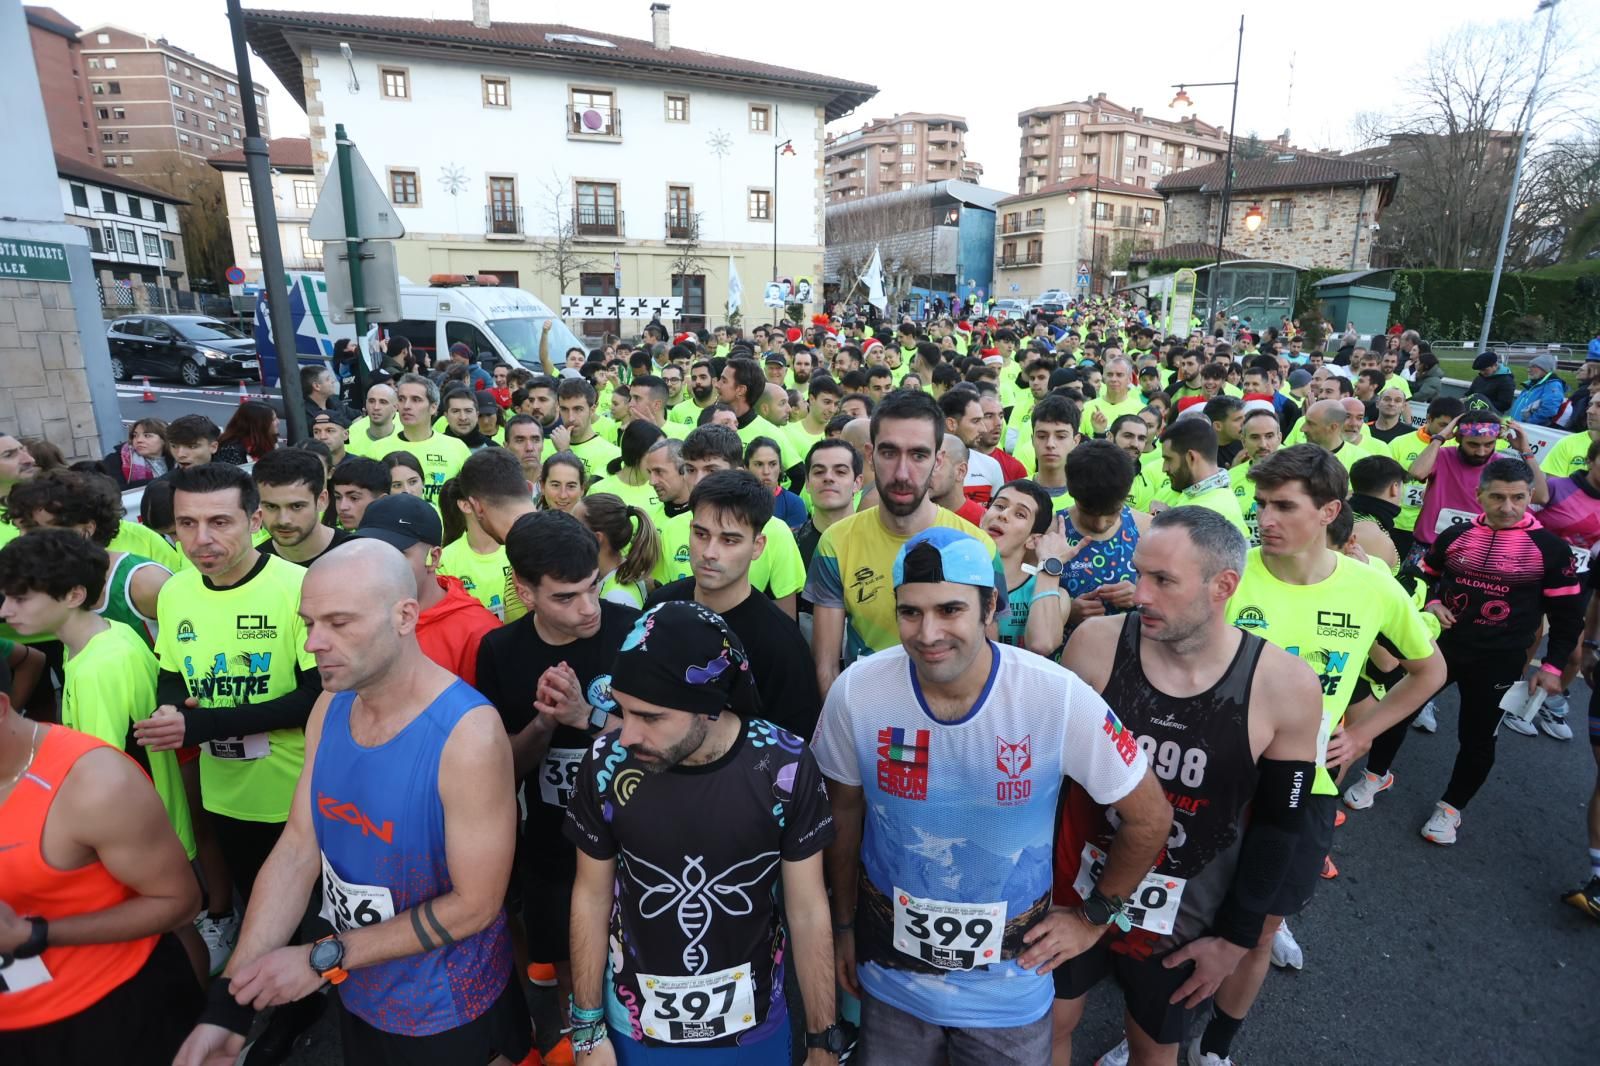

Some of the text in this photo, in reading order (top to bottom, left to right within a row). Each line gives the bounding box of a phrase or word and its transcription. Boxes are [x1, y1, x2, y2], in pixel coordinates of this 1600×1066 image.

[20, 244, 64, 261] URIARTE
[1455, 576, 1510, 593] GALDAKAO
[996, 779, 1032, 801] OTSO
[1288, 771, 1304, 808] KIPRUN
[905, 908, 993, 948] 399
[654, 981, 737, 1021] 397
